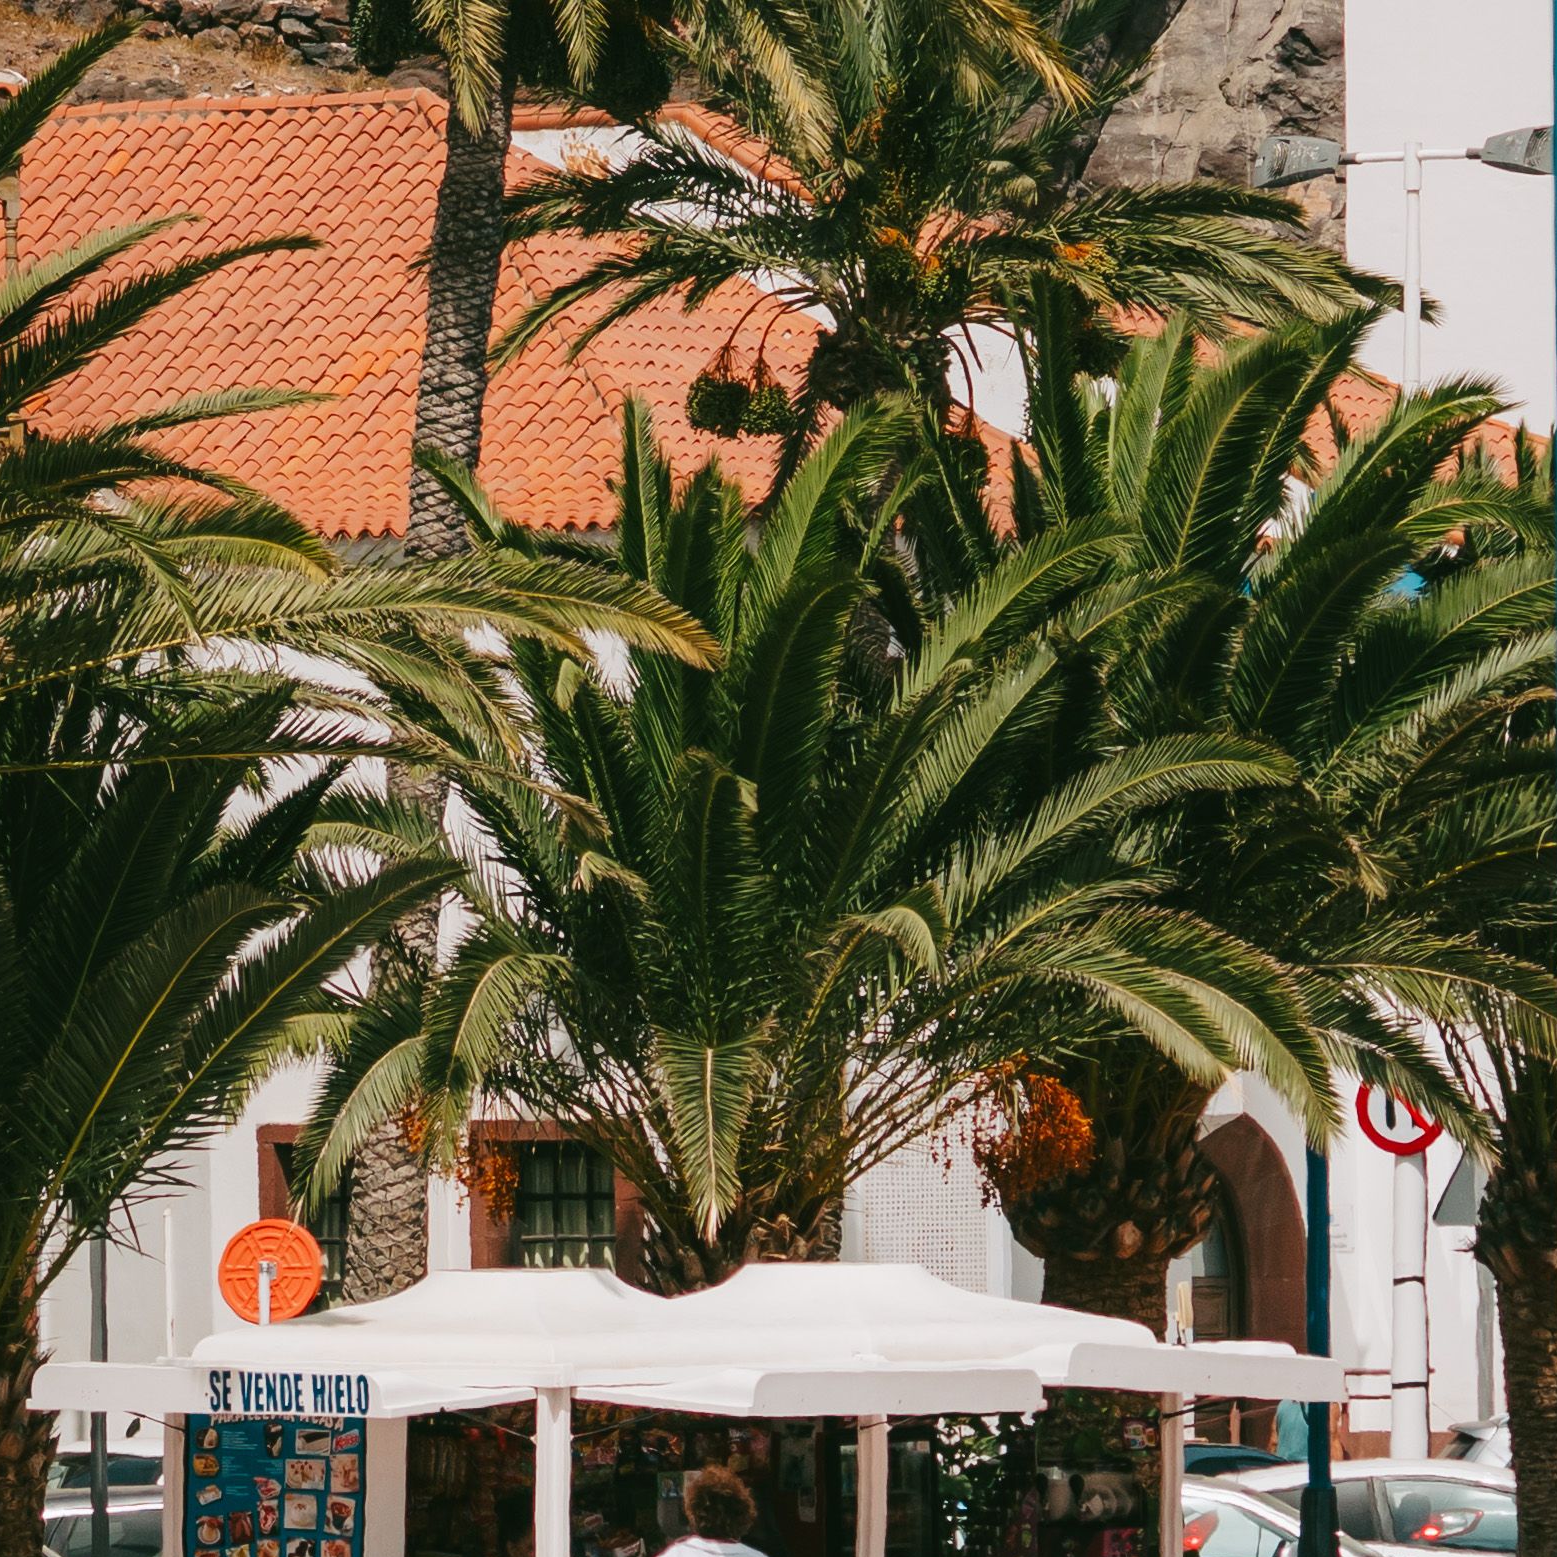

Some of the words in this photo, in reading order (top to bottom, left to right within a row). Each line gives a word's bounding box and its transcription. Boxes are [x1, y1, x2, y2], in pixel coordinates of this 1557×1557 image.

[209, 1370, 232, 1412] SE
[239, 1371, 305, 1412] VENDE
[312, 1373, 370, 1415] HIELO
